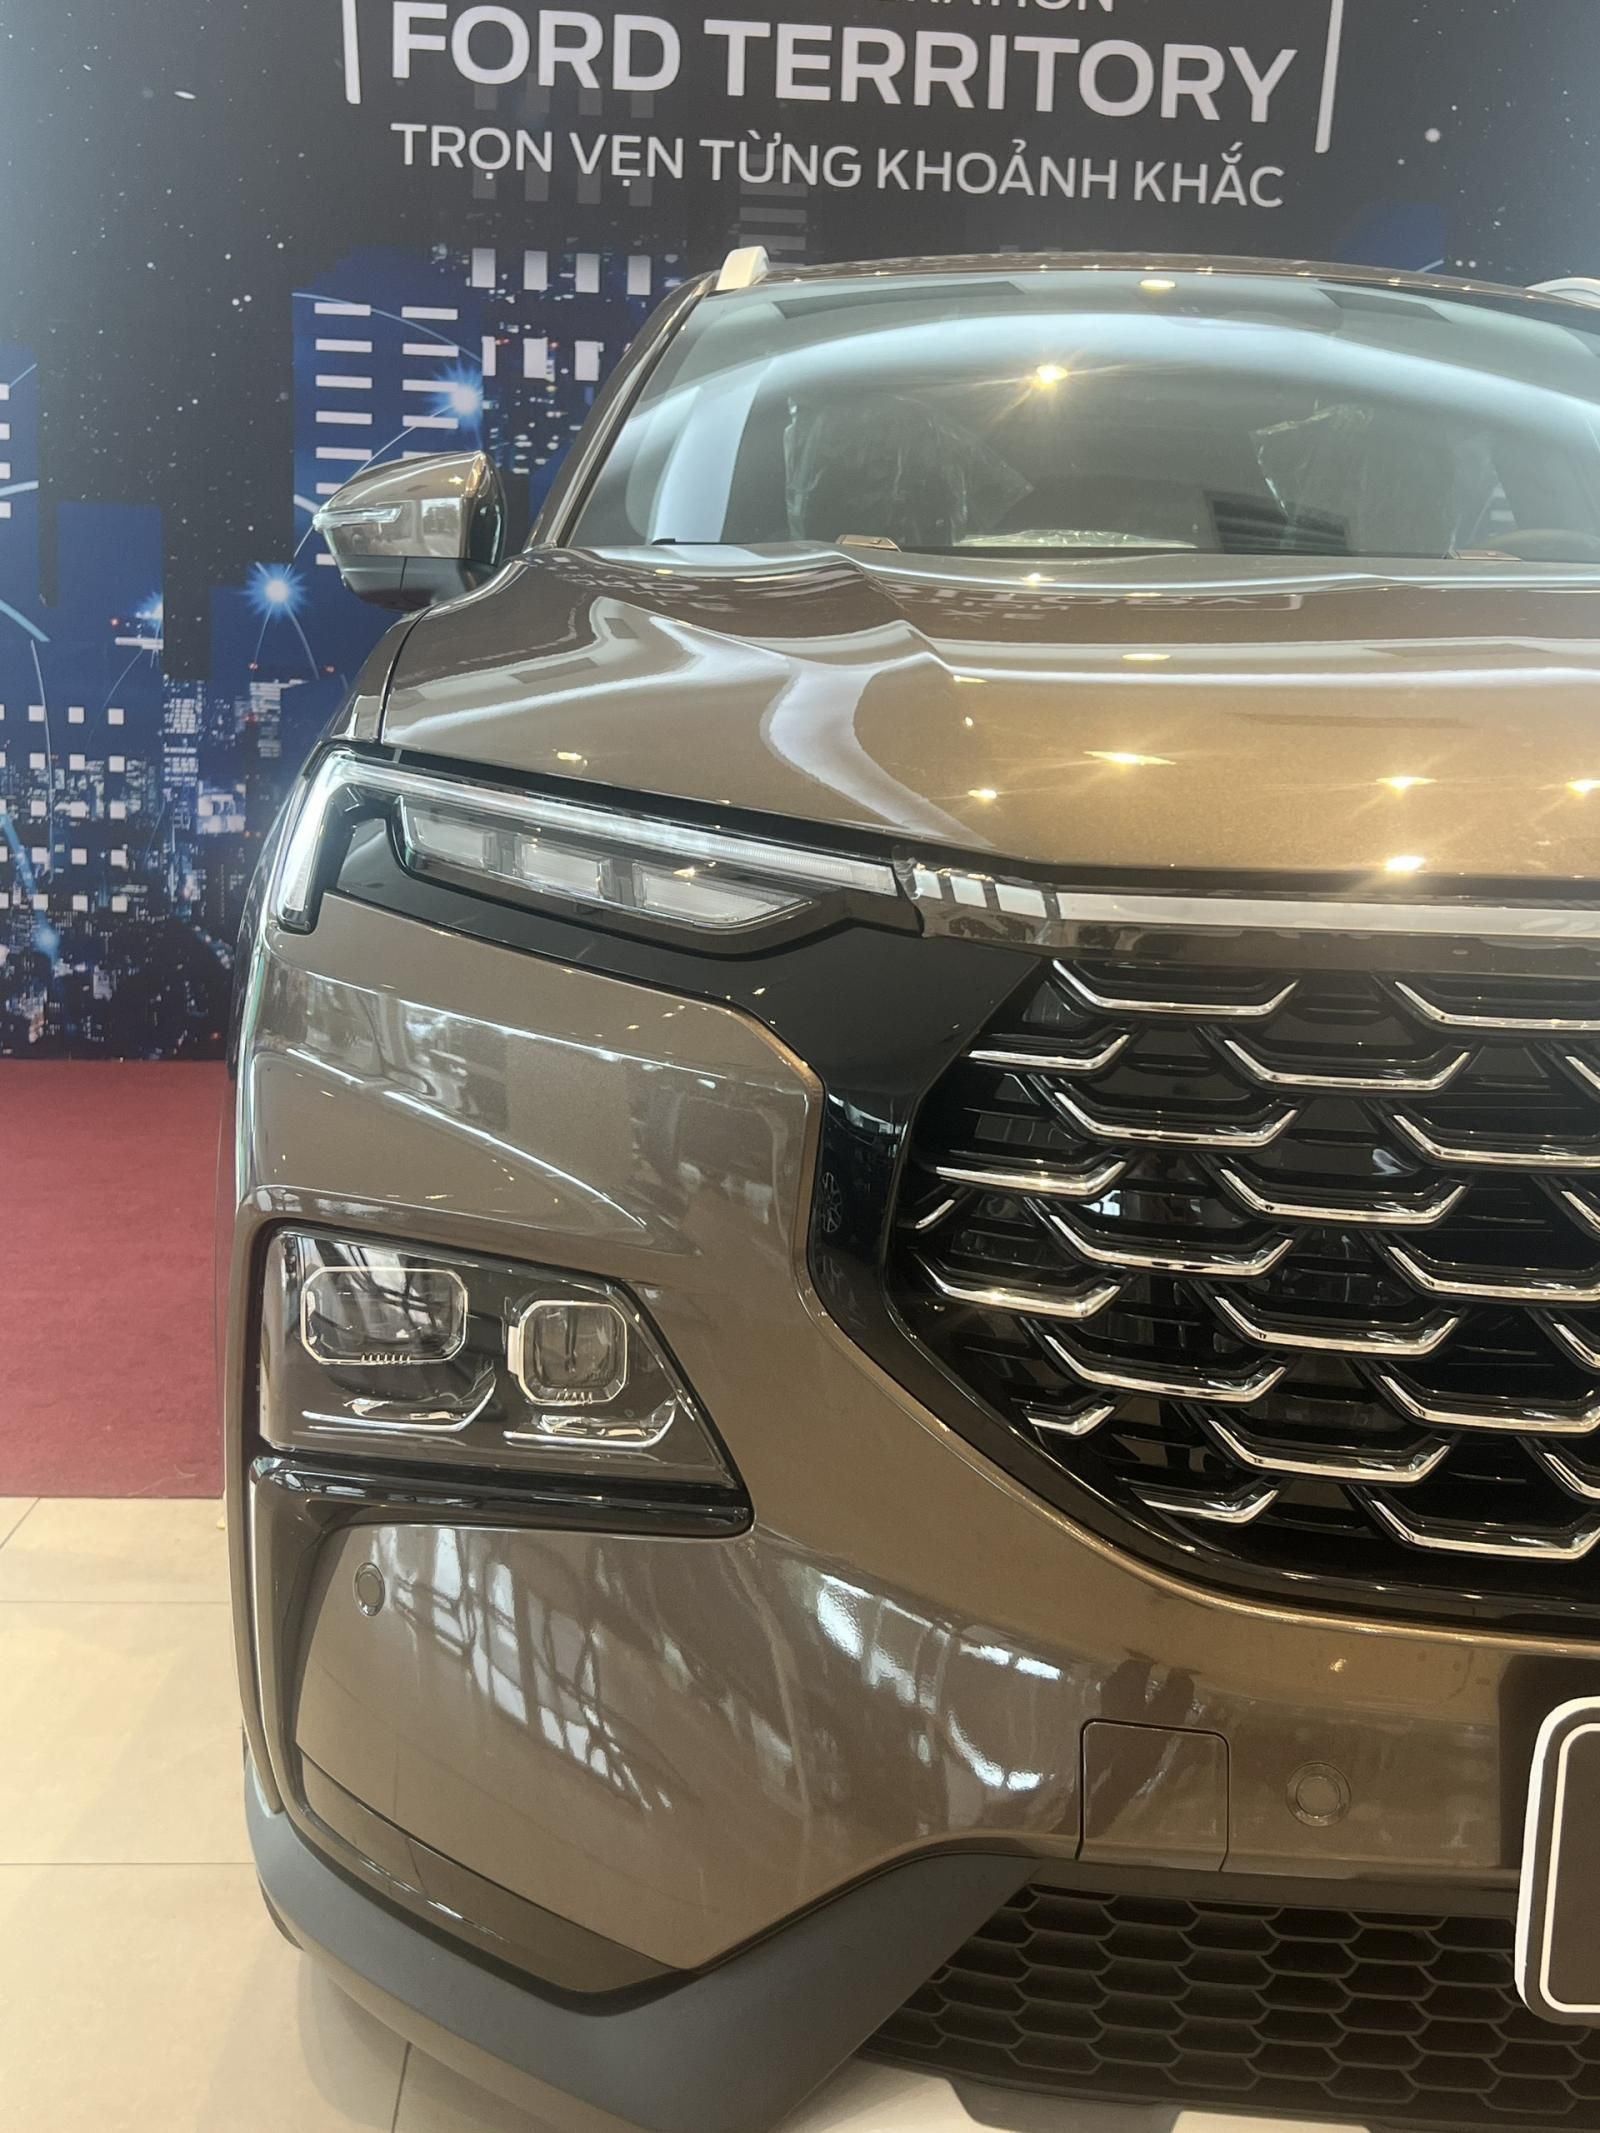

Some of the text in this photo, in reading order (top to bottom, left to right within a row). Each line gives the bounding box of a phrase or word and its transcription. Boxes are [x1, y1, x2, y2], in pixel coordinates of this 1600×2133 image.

[391, 1, 1297, 123] FORD TERRITORY
[390, 123, 1285, 208] TRỌN VẸN TỪNG KHOẢNH KHẮC
